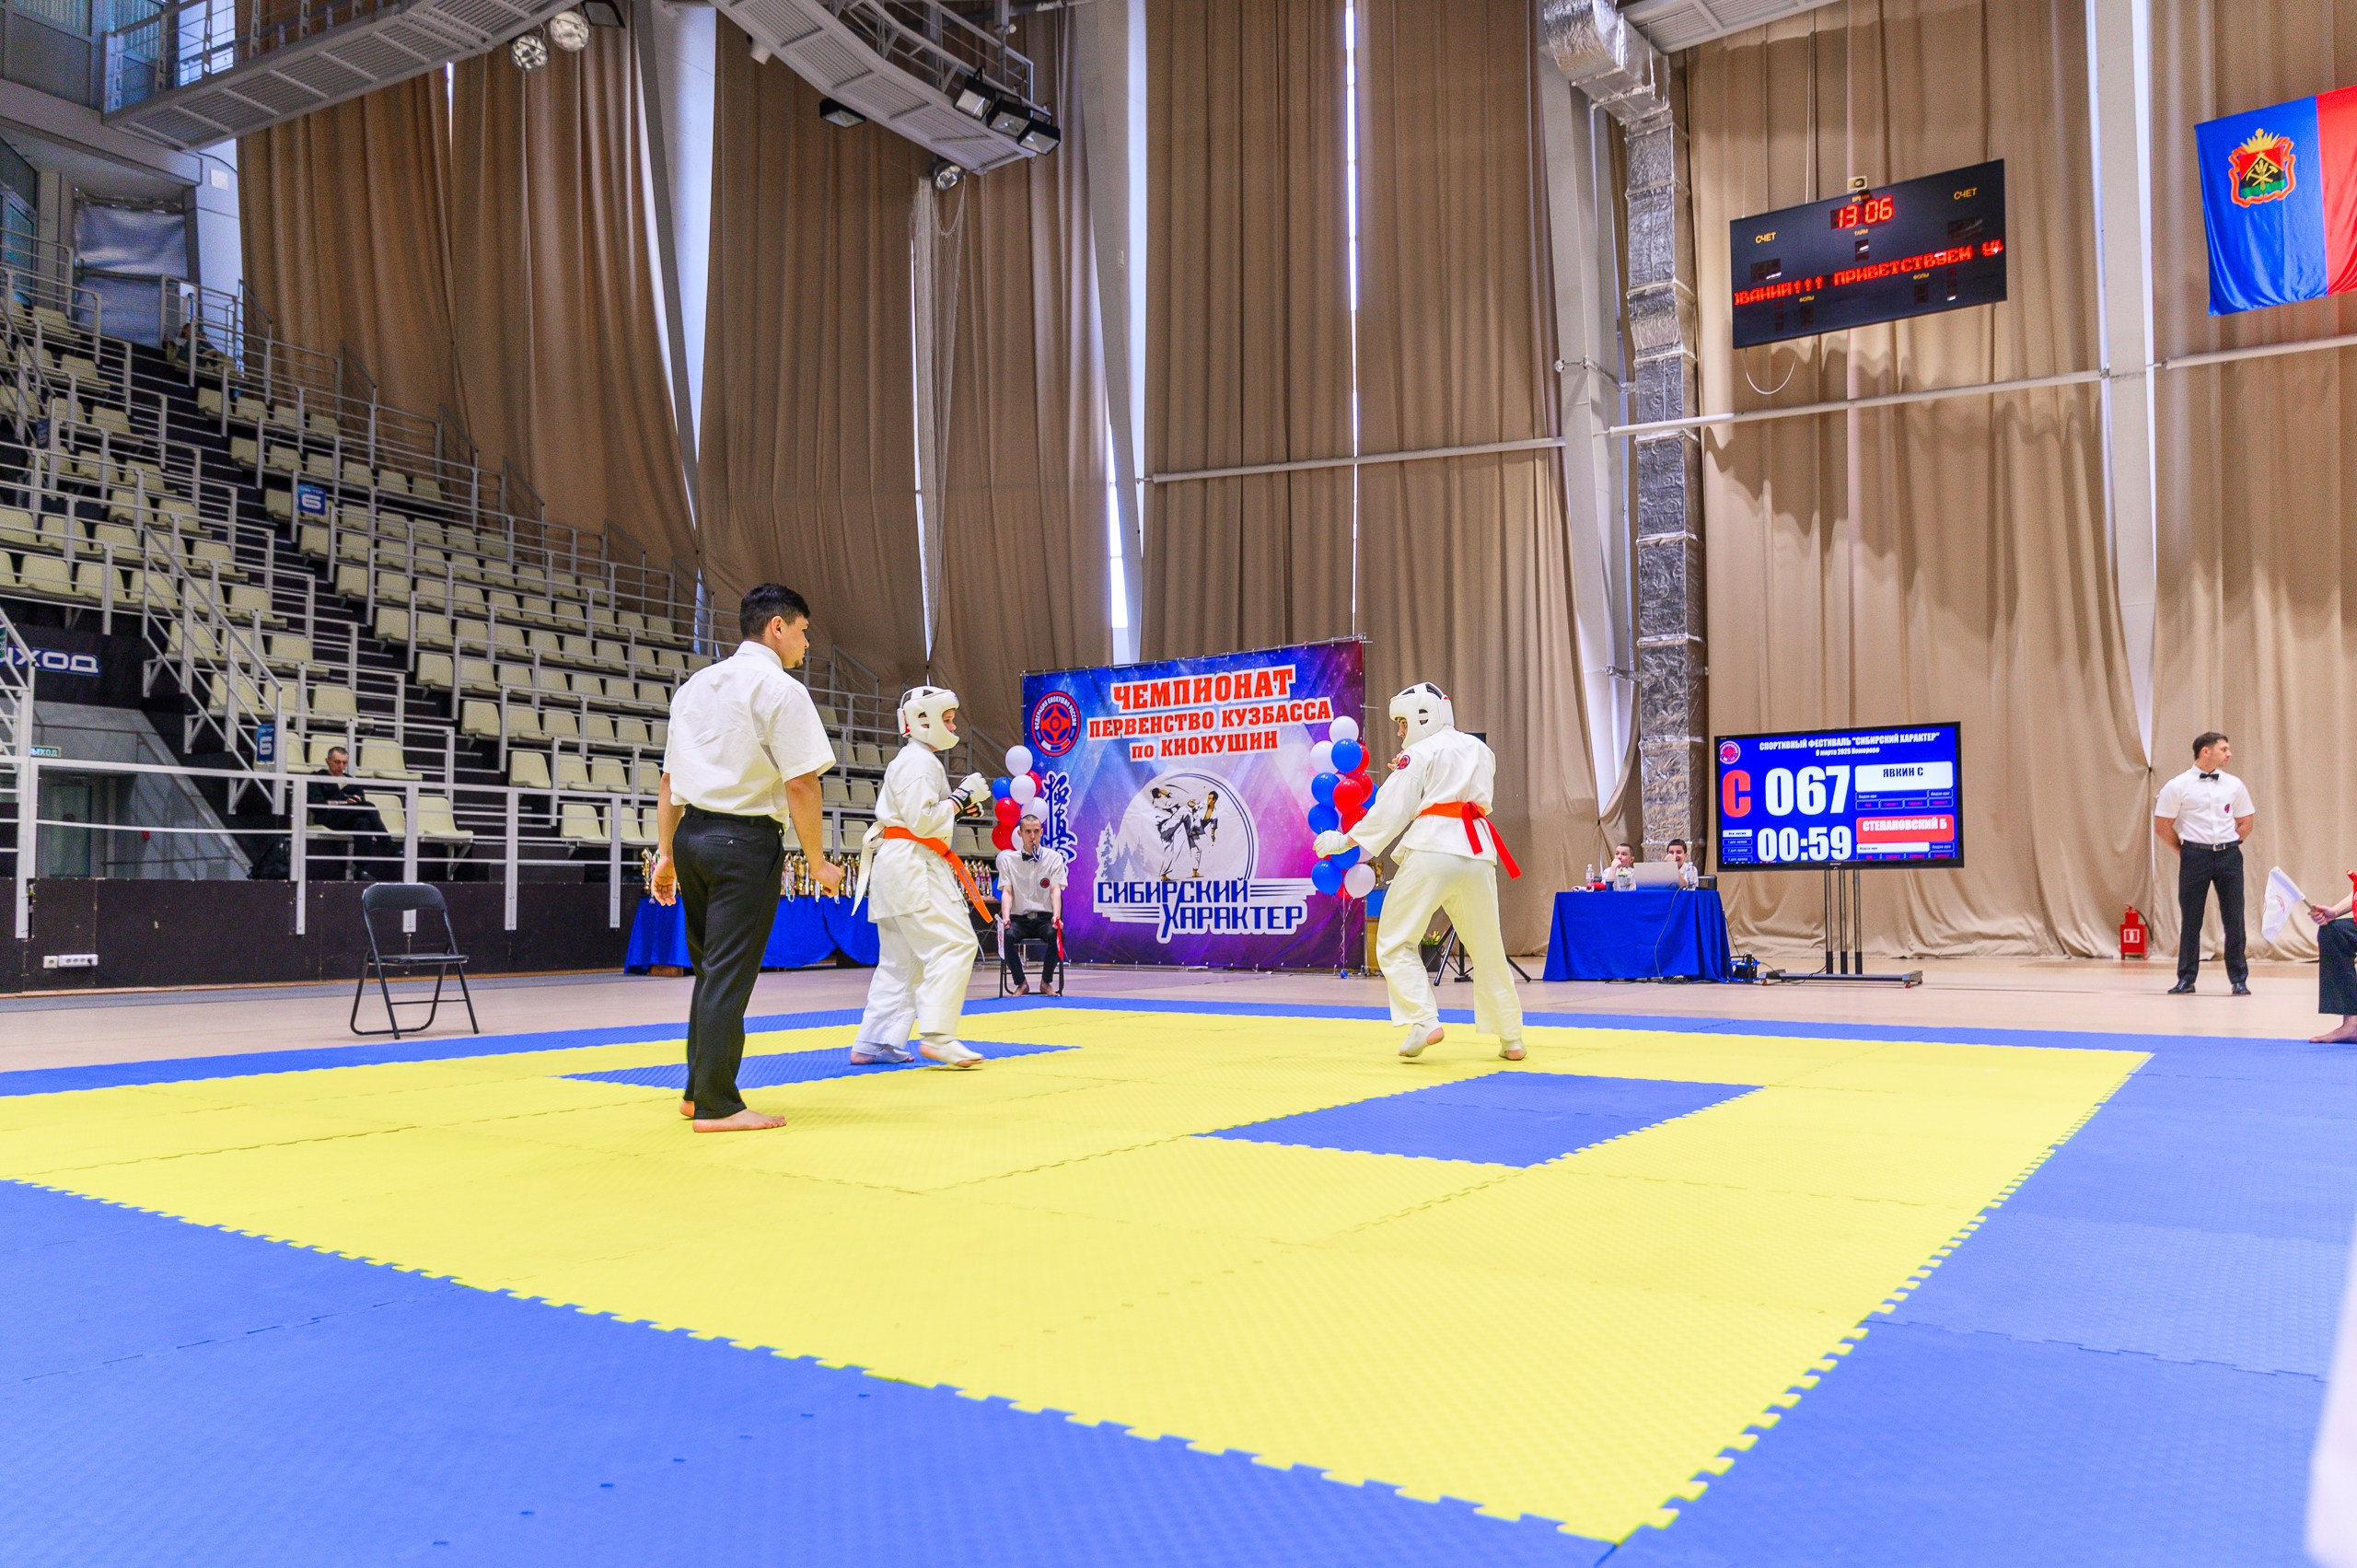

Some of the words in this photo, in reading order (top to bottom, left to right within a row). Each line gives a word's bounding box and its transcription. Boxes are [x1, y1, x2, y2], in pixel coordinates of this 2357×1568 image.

[1953, 187, 1978, 201] СЧЕТ
[1755, 231, 1776, 244] СЧЕТ
[1833, 244, 1973, 286] ПРИВЕТСТВУЕМ
[301, 494, 321, 510] 6
[1113, 668, 1294, 711] ЧЕМПИОНАТ
[1088, 713, 1214, 738] ПЕРВЕНСТВО
[1221, 700, 1331, 728] КУЗБАССА
[29, 748, 57, 758] ЫХОД
[259, 736, 273, 755] 6
[1160, 731, 1278, 757] КИОКУШИН
[1759, 738, 1807, 751] СПОРТИВНЫЙ
[1807, 737, 1852, 749] ФЕСТИВАЛЬ
[1852, 733, 1898, 746] "СИБИРСКИЙ
[1883, 767, 1915, 778] ЯВКИН
[1917, 767, 1923, 777] С
[1765, 764, 1851, 817] 067
[1862, 817, 1938, 832] СТЕПАНОВСКИЙ
[1939, 817, 1947, 830] Б
[1757, 825, 1852, 861] 00:59
[1097, 877, 1249, 904] СИБИРСКИЙ
[1160, 893, 1303, 937] ХАРАКТЕР
